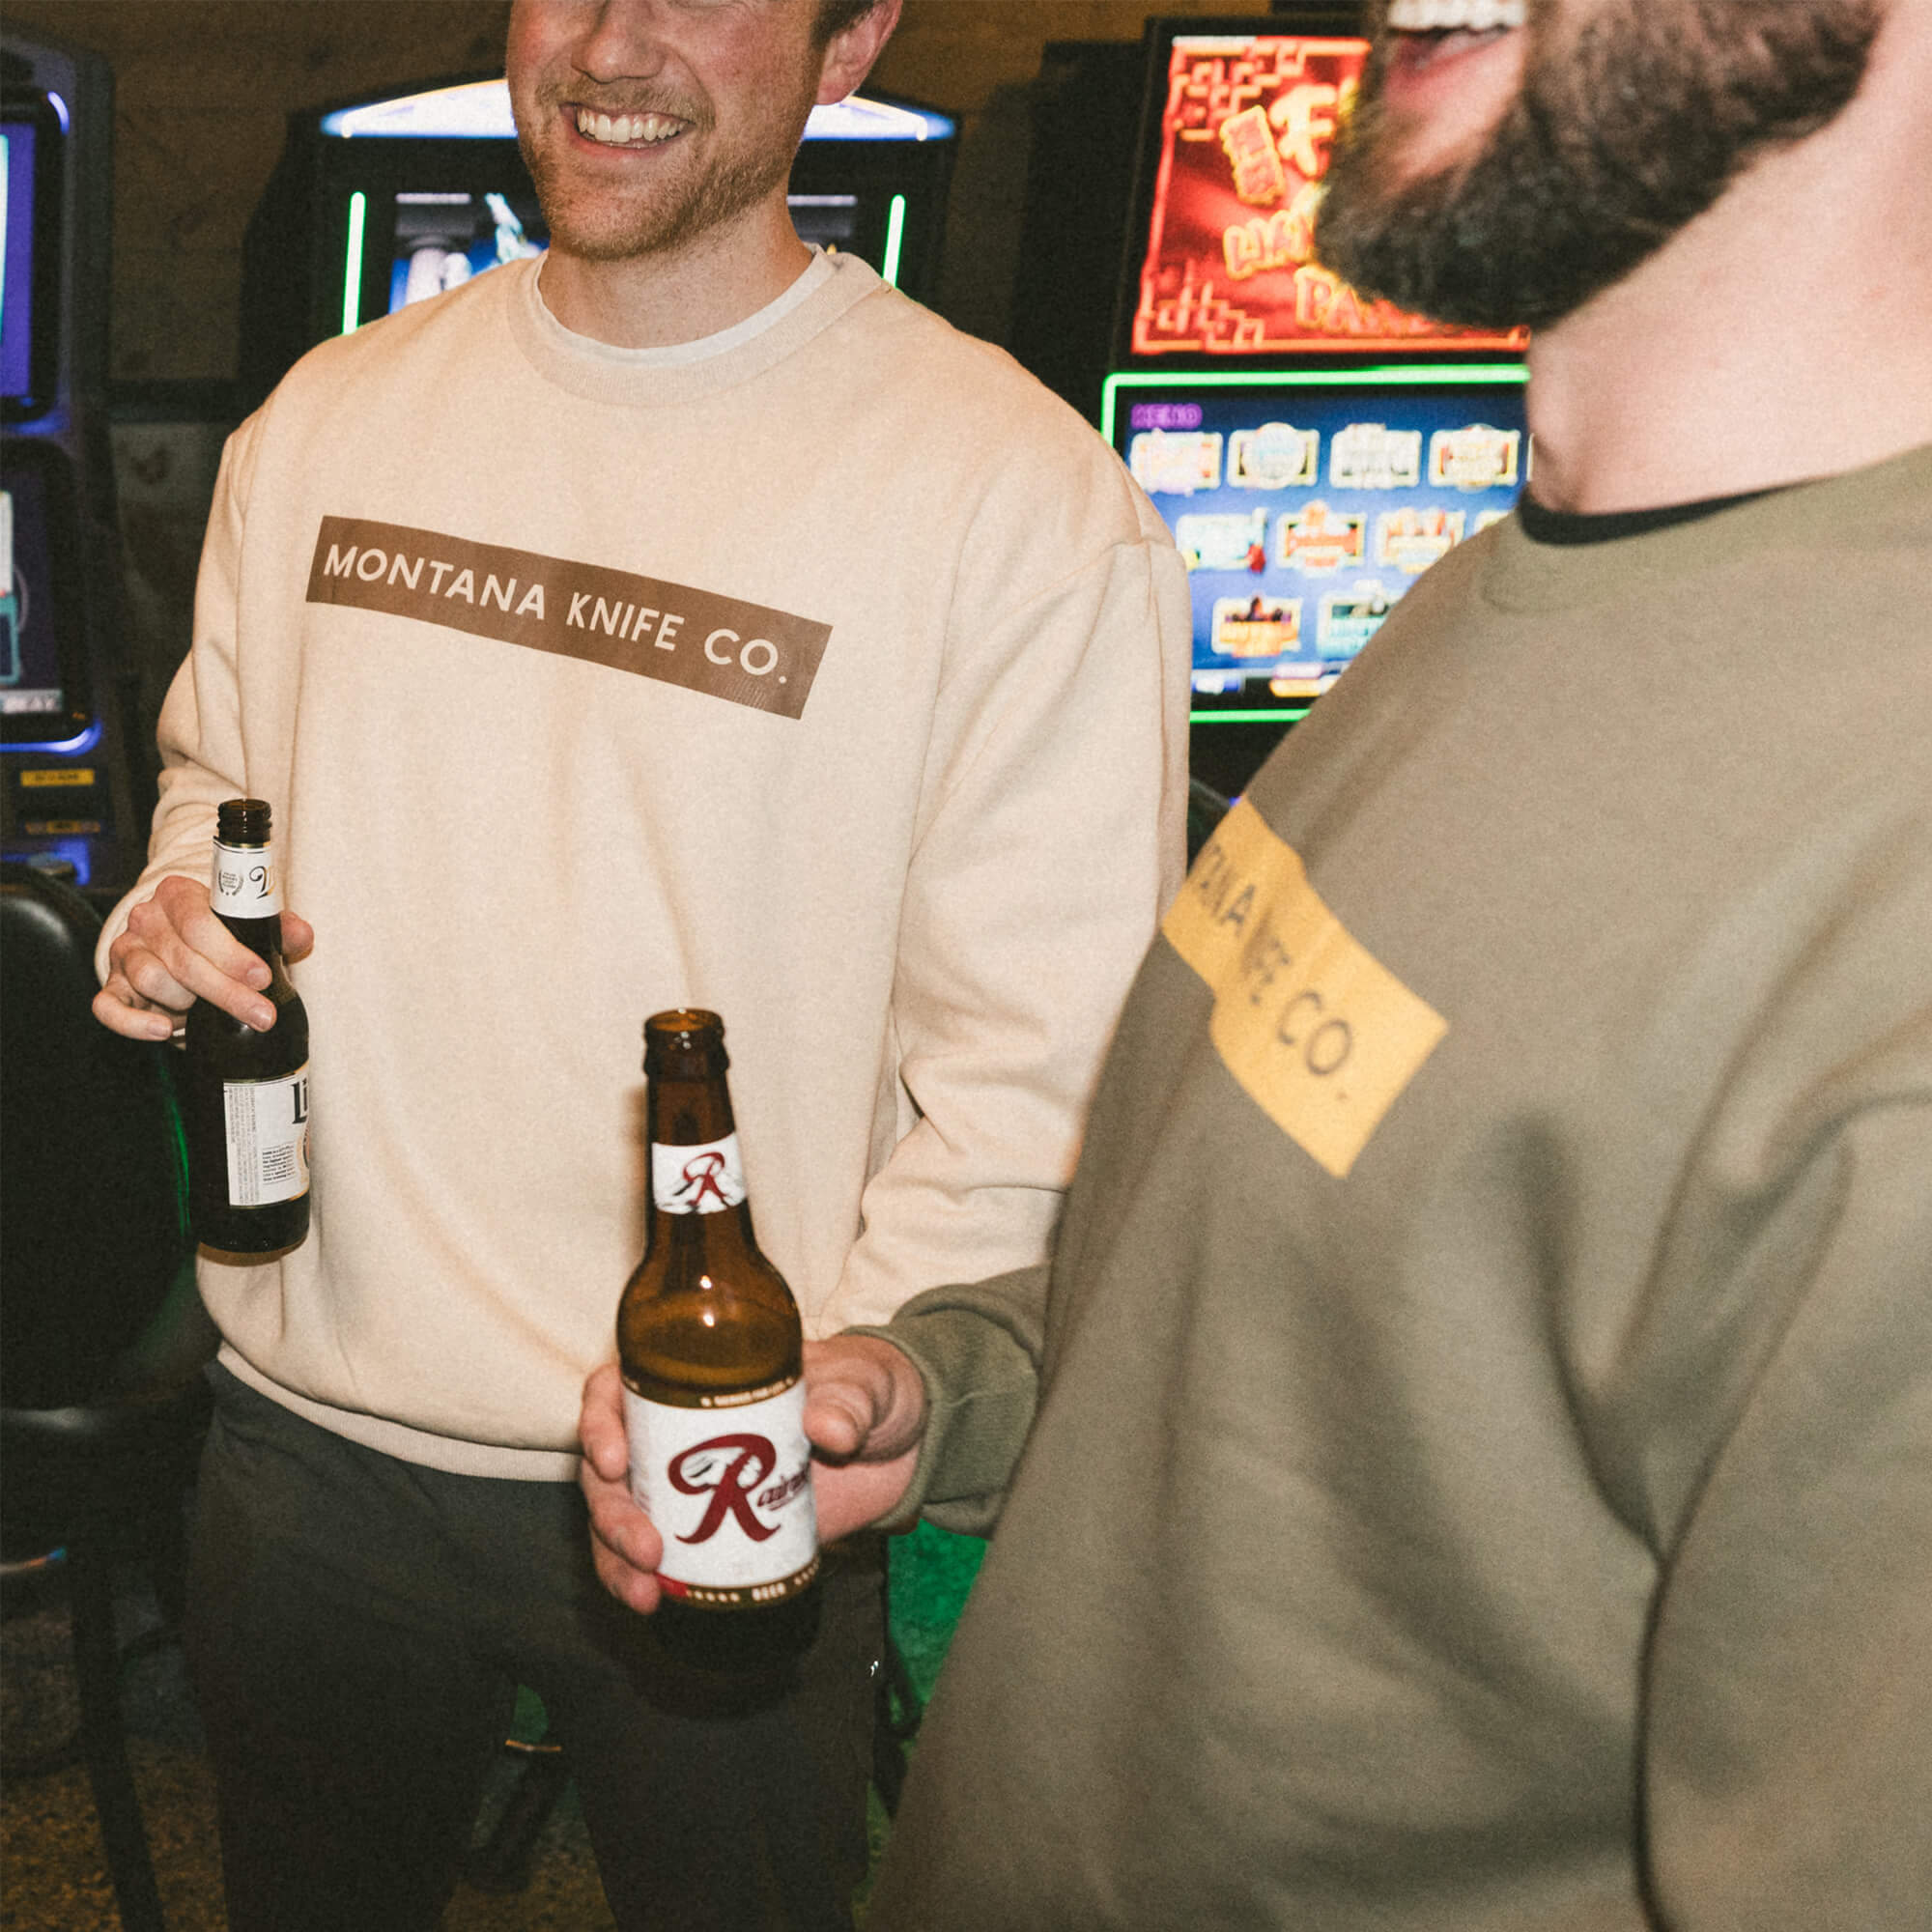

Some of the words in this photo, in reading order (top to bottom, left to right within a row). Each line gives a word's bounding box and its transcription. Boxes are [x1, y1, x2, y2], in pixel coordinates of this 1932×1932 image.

[324, 543, 546, 620] MONTANA
[566, 591, 686, 651] KNIFE
[703, 628, 787, 684] CO.
